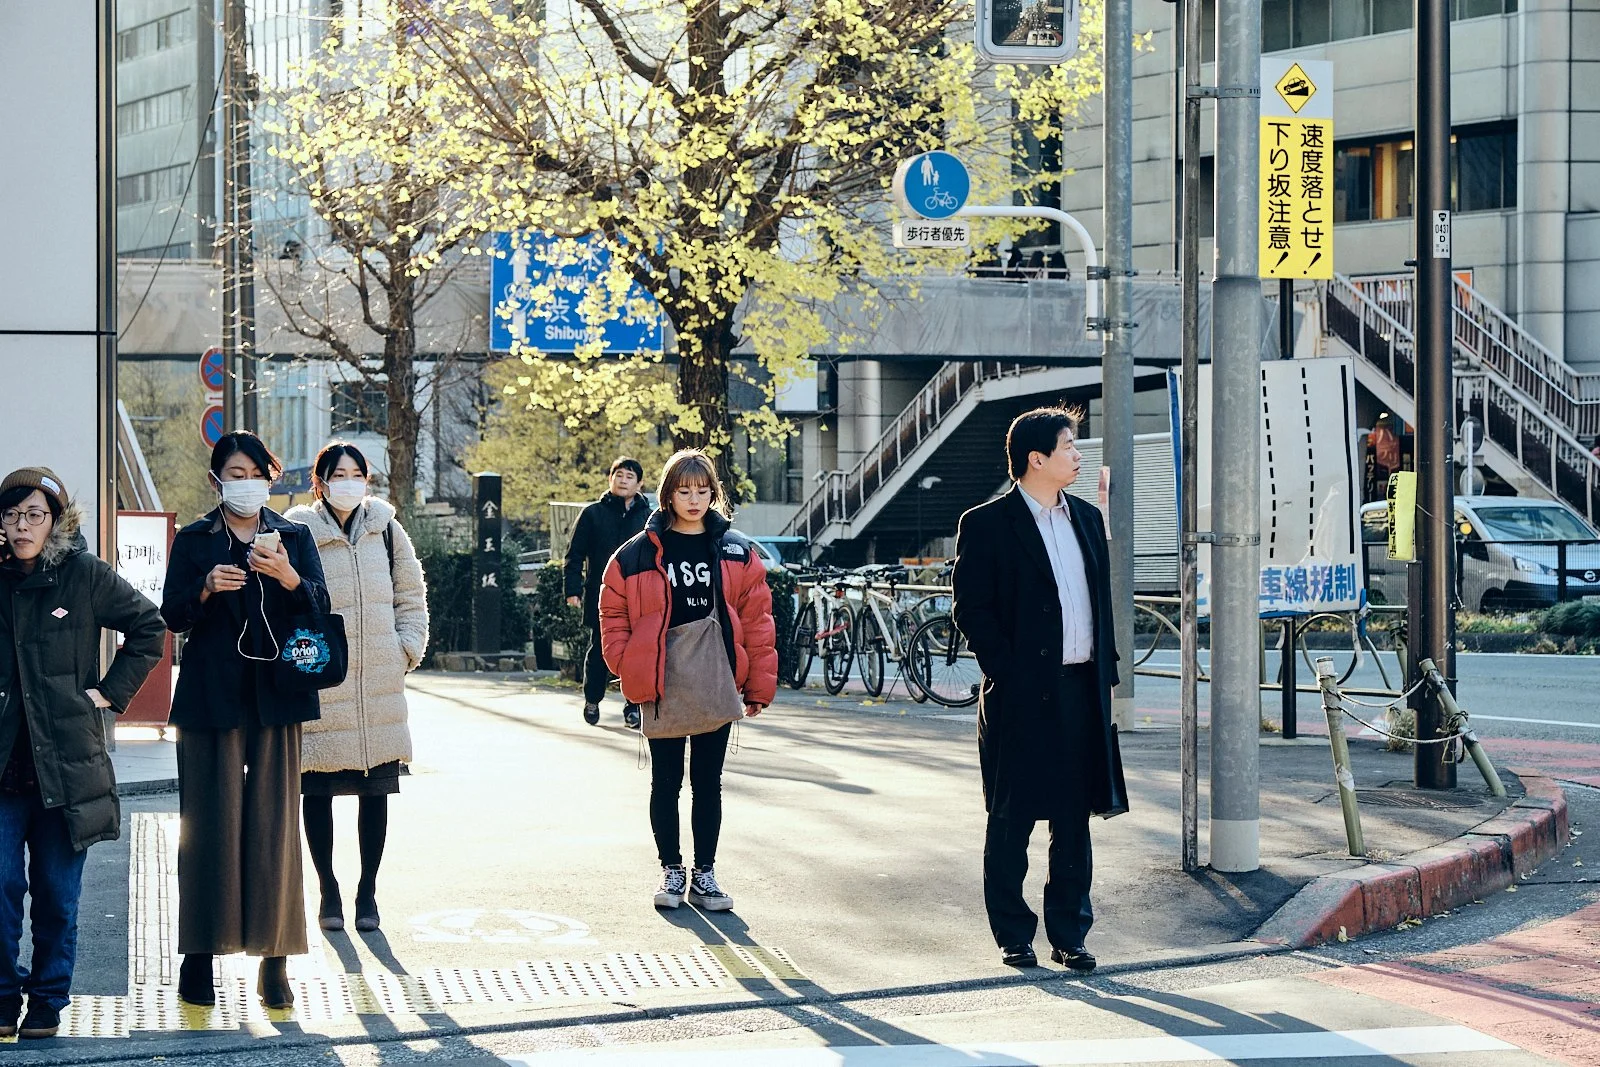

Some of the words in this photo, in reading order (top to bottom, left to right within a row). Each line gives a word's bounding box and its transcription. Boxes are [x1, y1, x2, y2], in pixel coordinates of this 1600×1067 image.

[907, 226, 965, 241] 歩行者優先
[1267, 122, 1291, 274] 下り坂注意!
[1301, 123, 1323, 275] 速度落とせ!
